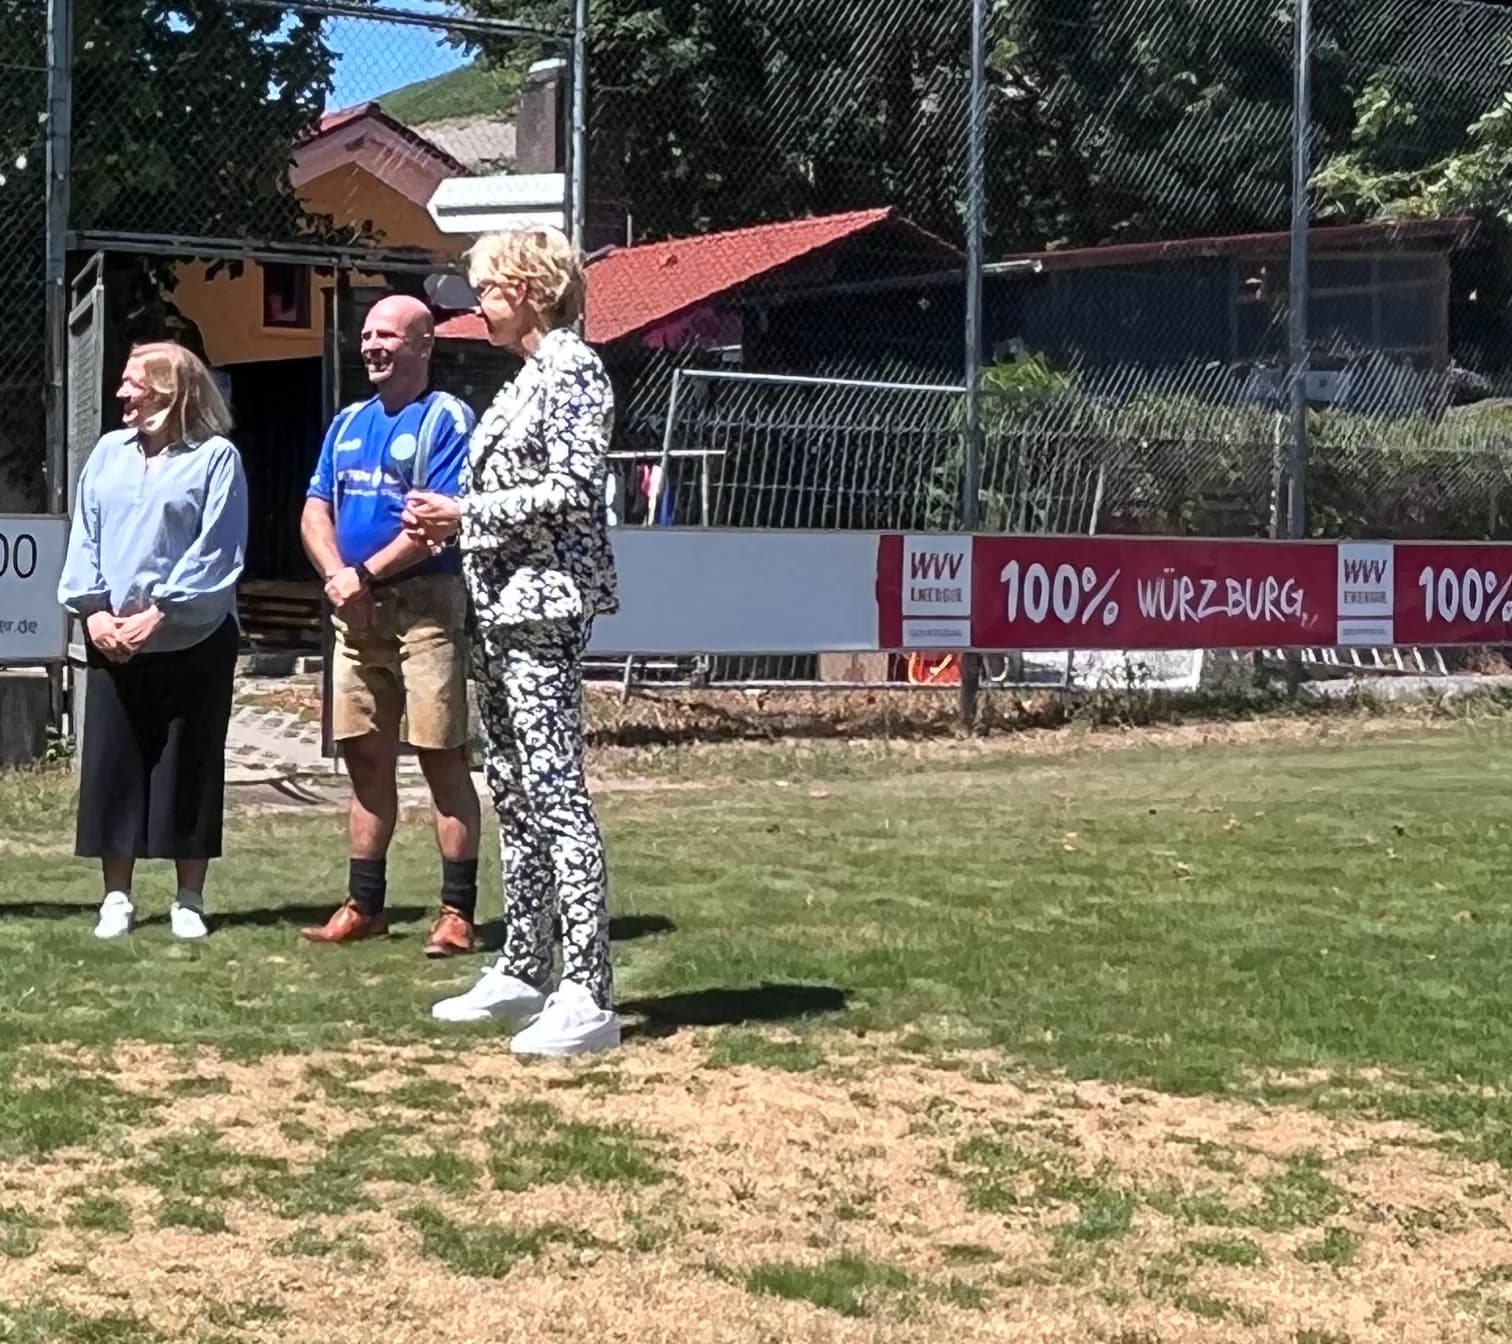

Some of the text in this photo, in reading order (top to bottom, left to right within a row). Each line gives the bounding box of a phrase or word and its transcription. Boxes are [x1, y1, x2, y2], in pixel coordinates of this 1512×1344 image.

[910, 552, 964, 580] WVV
[1343, 559, 1388, 584] WVV
[1000, 559, 1121, 626] 100%
